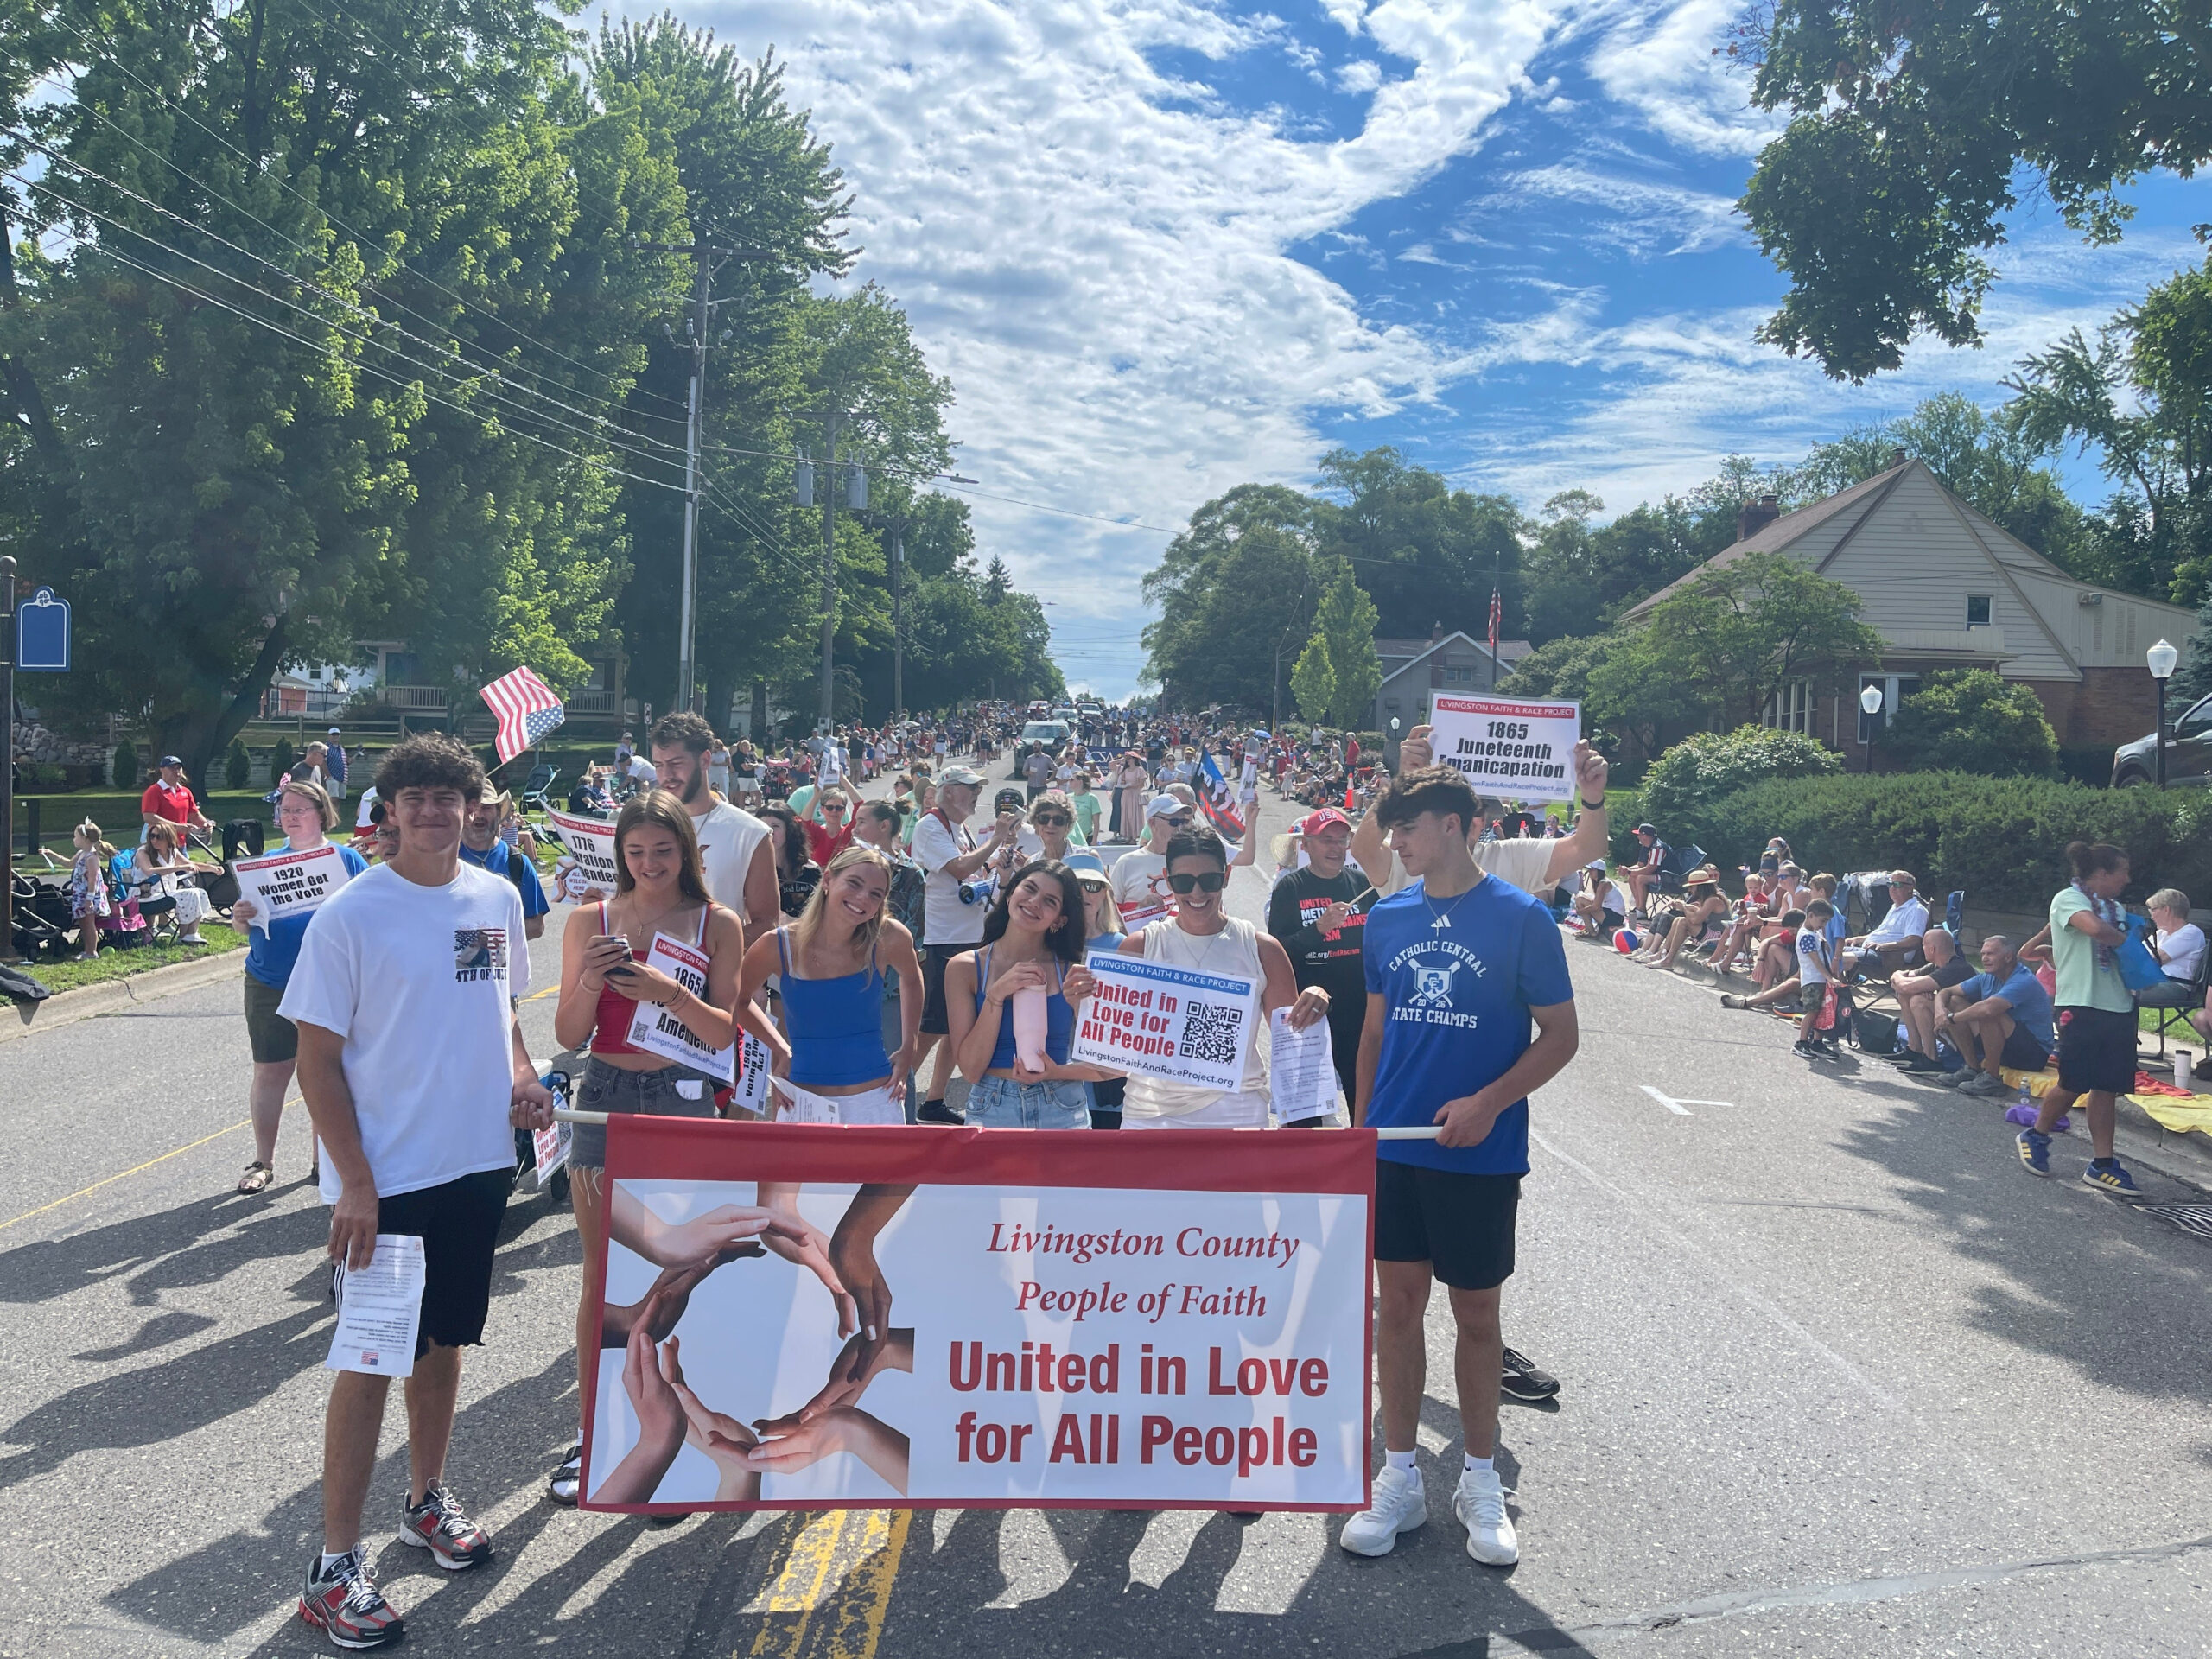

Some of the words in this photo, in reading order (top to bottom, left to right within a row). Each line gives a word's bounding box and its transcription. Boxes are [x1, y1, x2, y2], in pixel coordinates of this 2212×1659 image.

[1440, 700, 1489, 711] LIVINGSTON
[1487, 721, 1529, 740] 1865
[1456, 738, 1552, 760] Juneteenth
[1471, 780, 1568, 794] onFaithAndRaceProject.org
[1319, 810, 1338, 822] USA
[571, 835, 596, 853] 1776
[570, 848, 615, 869] aration
[257, 880, 305, 896] Women
[308, 873, 329, 886] Get
[273, 866, 304, 881] 1920
[271, 894, 293, 906] the
[295, 887, 324, 900] Vote
[1299, 897, 1332, 909] UNITED
[657, 940, 695, 963] LIVINGSTON
[1389, 941, 1439, 972] CATHOLIC
[1441, 941, 1487, 978] CENTRAL
[455, 969, 478, 982] 4TH
[480, 969, 492, 981] OF
[493, 969, 507, 980] JUL
[674, 966, 705, 995] 1865-
[1094, 959, 1145, 975] LIVINGSTON
[1146, 967, 1172, 979] FAITH
[1173, 972, 1180, 981] &
[1183, 974, 1205, 985] RACE
[1207, 979, 1247, 993] PROJECT
[1159, 992, 1178, 1014] in
[1092, 1001, 1135, 1027] Love
[1141, 1013, 1171, 1033] for
[1426, 1009, 1478, 1029] CHAMPS
[1081, 1020, 1105, 1042] All
[1110, 1027, 1175, 1058] People
[743, 1042, 752, 1068] 1965
[756, 1052, 765, 1071] Act
[1078, 1046, 1234, 1088] LivingstonFaithAndRaceProject.org
[746, 1060, 758, 1097] Voting
[986, 1222, 1164, 1264] Livingston
[1175, 1226, 1300, 1268] County
[1014, 1281, 1128, 1322] People
[1136, 1282, 1176, 1324] of
[1177, 1284, 1268, 1318] Faith
[950, 1340, 1120, 1394] United
[1140, 1344, 1187, 1395] in
[1209, 1346, 1330, 1397] Love
[955, 1411, 1033, 1464] for
[1049, 1414, 1120, 1465] All
[1140, 1414, 1319, 1478] People
